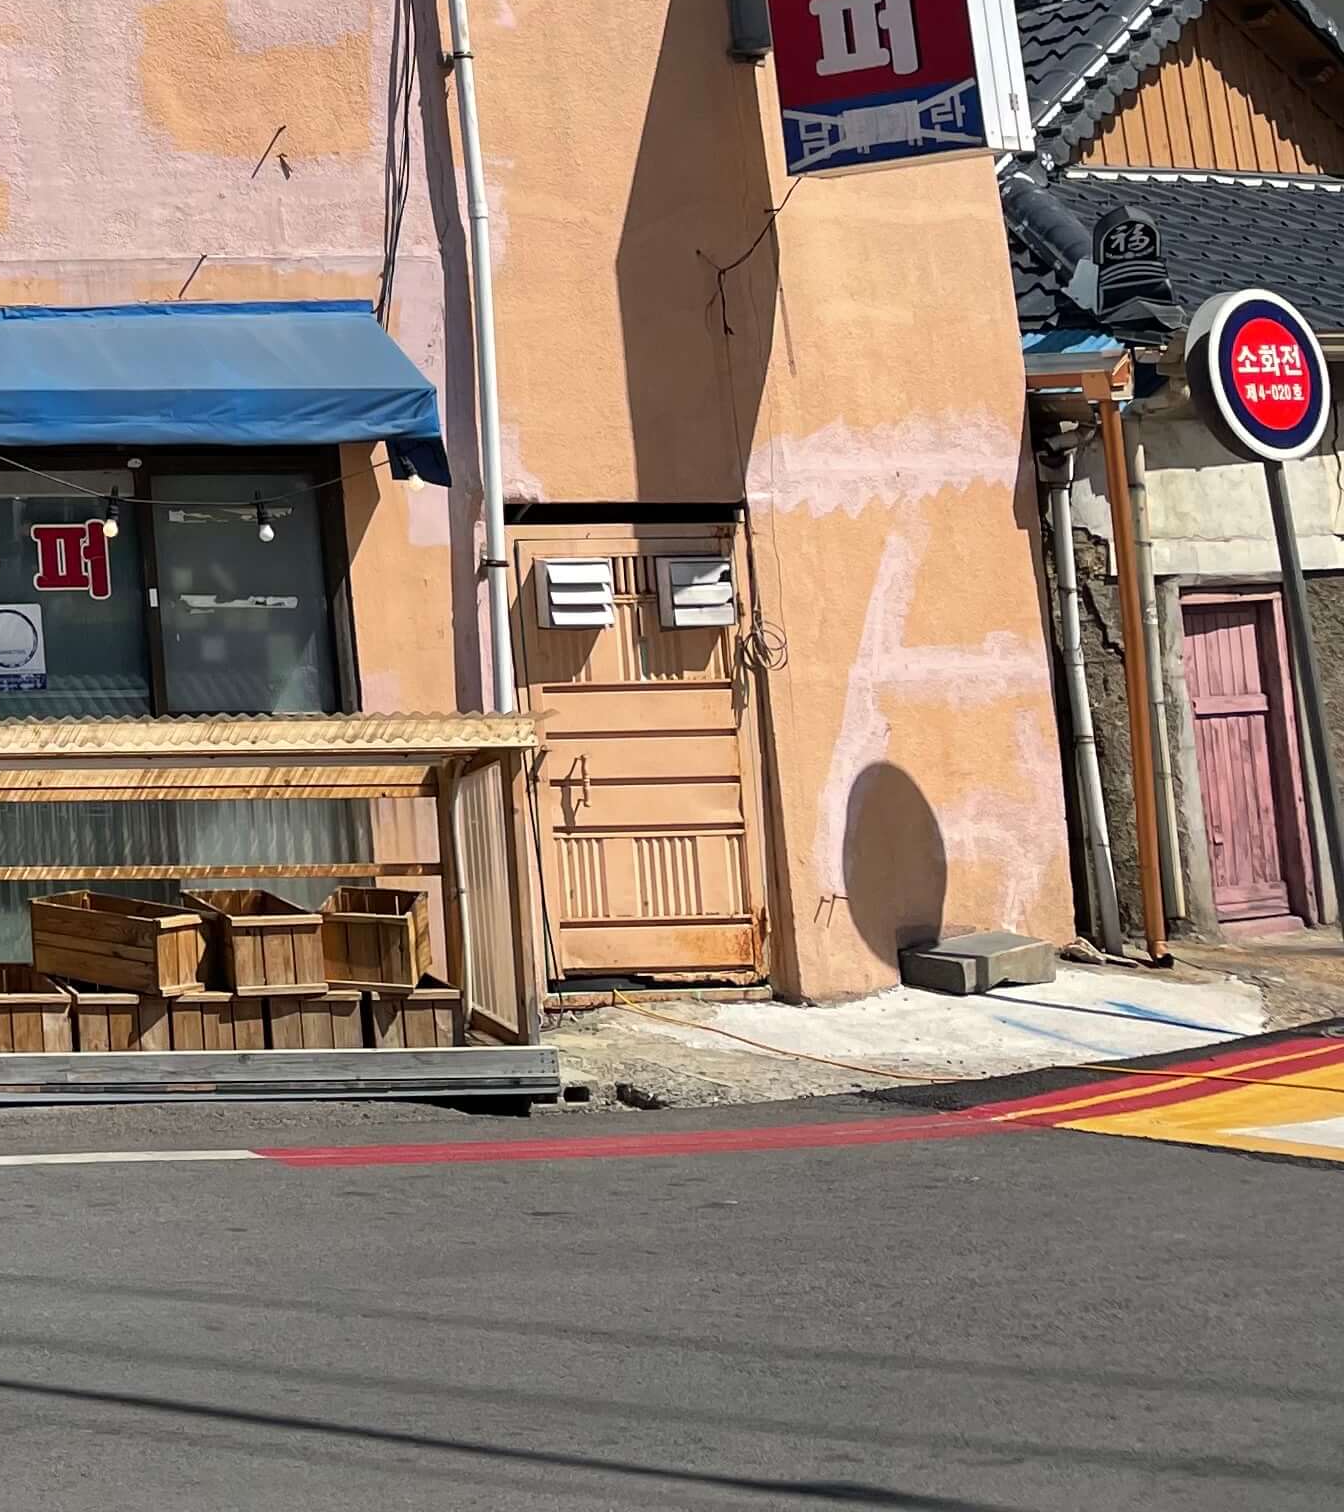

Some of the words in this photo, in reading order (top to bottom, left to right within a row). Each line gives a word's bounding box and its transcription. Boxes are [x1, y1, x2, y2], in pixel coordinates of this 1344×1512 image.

[1109, 223, 1154, 253] 福
[1235, 343, 1304, 377] 소화전
[1244, 383, 1305, 403] 제4-020호
